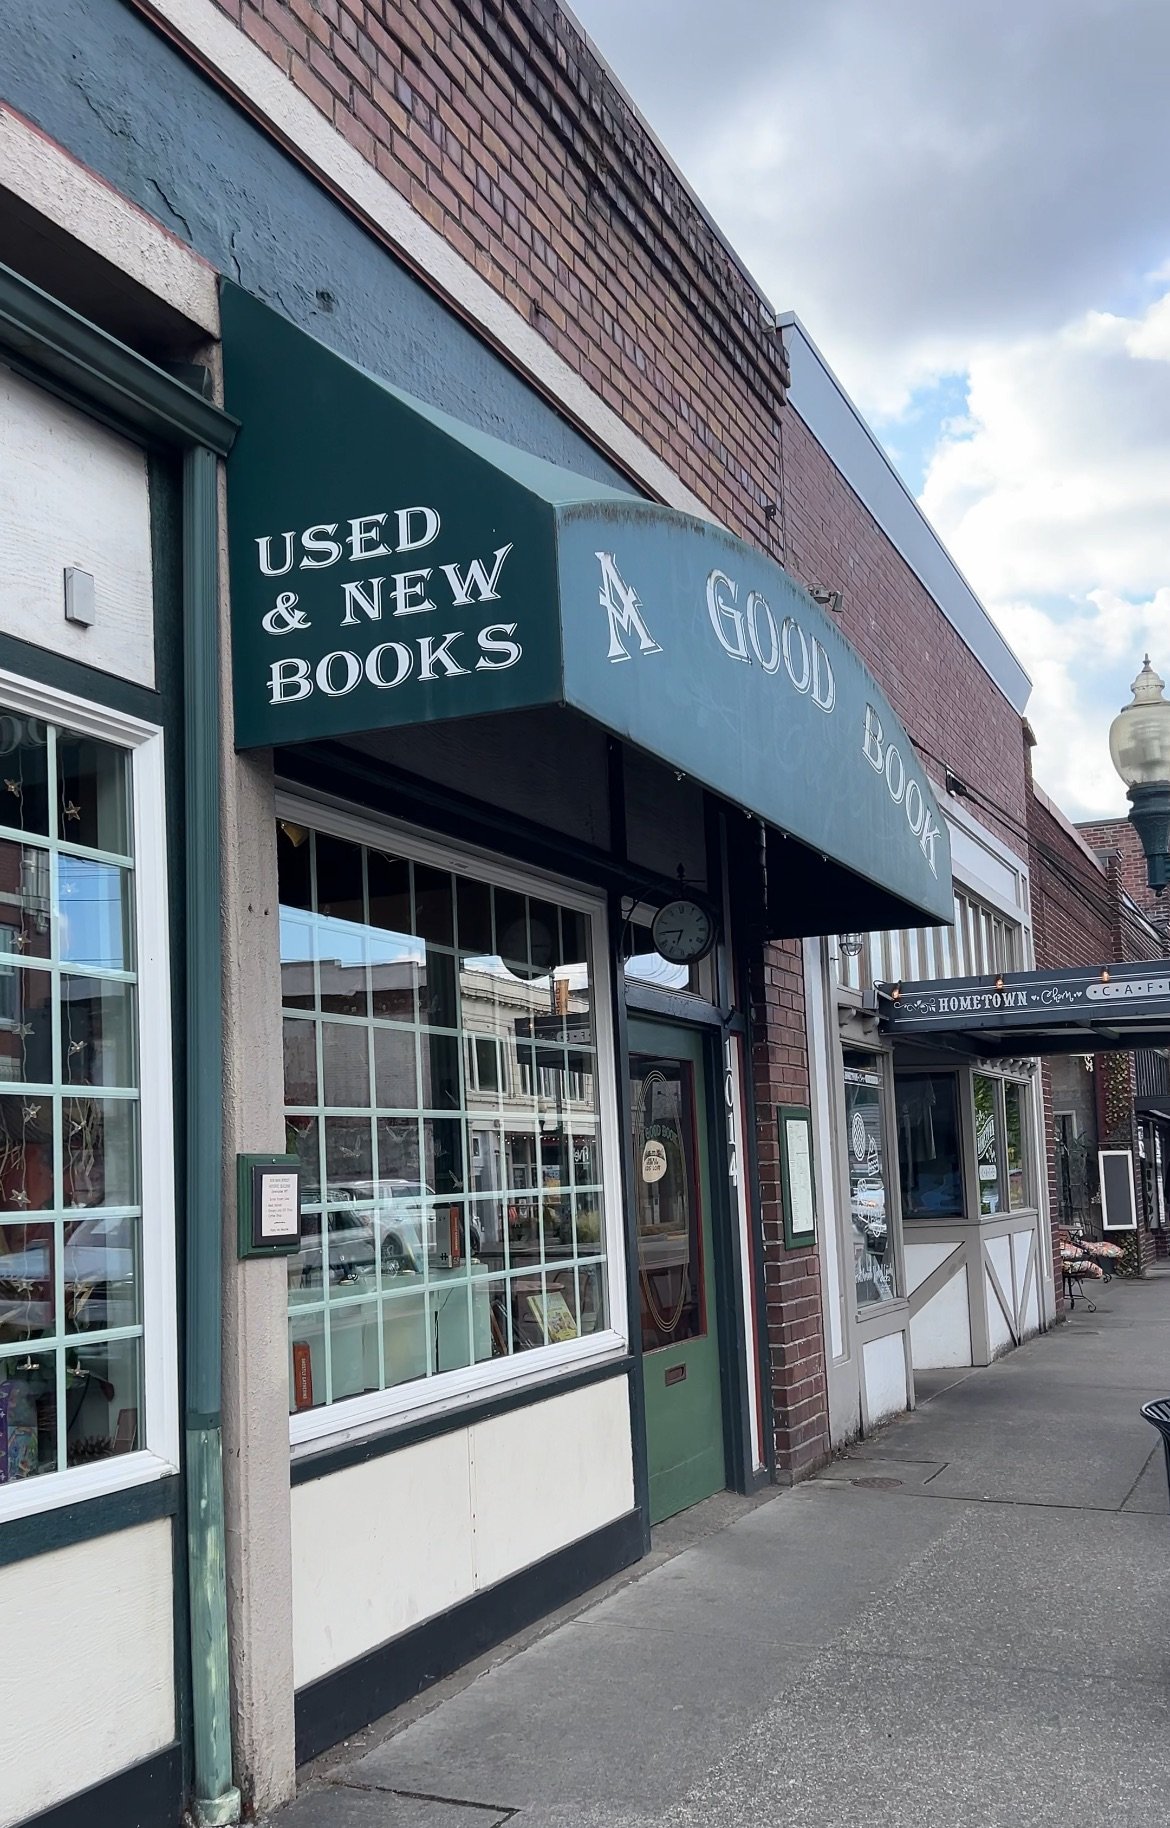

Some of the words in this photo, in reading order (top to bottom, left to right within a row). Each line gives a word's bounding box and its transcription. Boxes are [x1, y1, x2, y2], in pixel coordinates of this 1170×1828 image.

[254, 506, 441, 577] USED
[261, 591, 312, 636] &
[339, 542, 514, 626] NEW
[266, 622, 523, 705] BOOKS
[594, 551, 664, 663] A
[706, 568, 837, 714] GOOD
[861, 702, 942, 880] BOOK
[938, 991, 1028, 1012] HOMETOWN
[1041, 987, 1074, 1004] Charm
[724, 1038, 738, 1187] 1014
